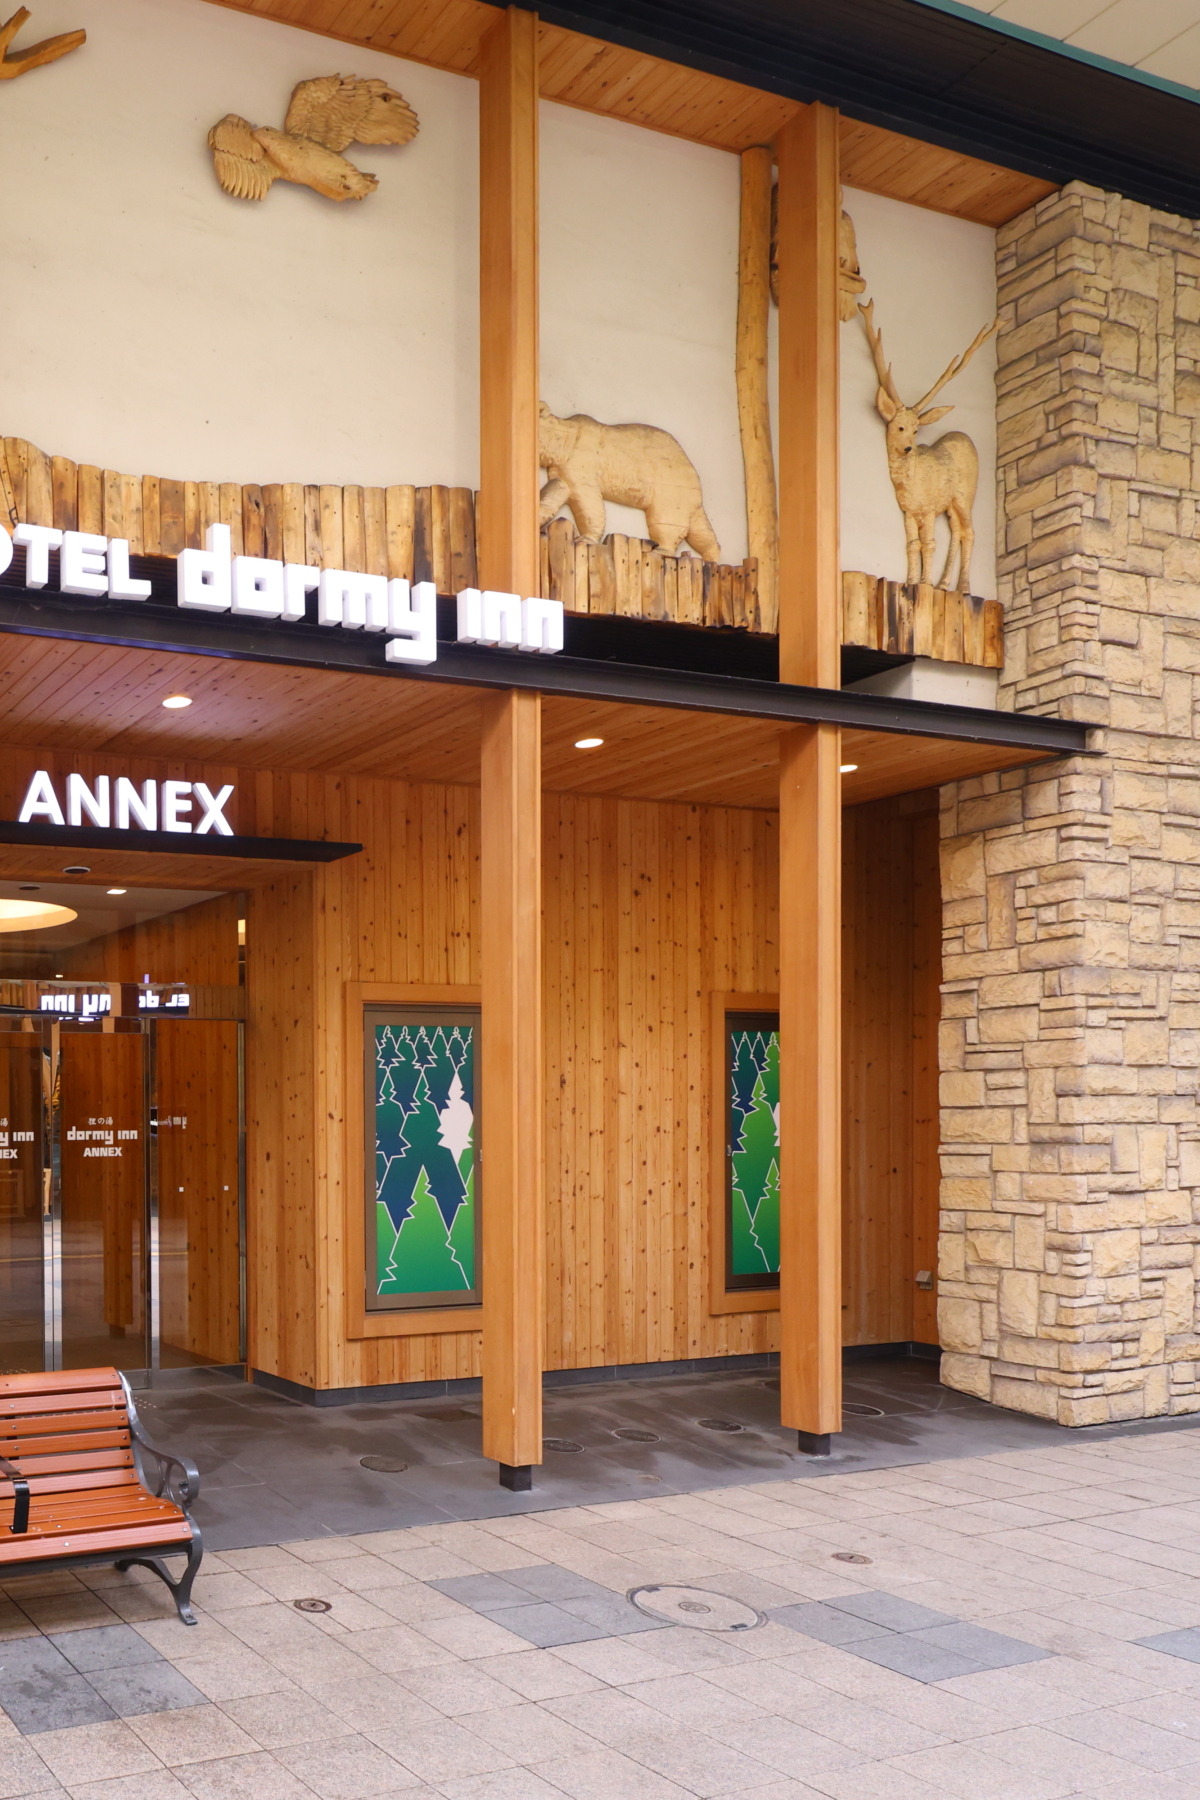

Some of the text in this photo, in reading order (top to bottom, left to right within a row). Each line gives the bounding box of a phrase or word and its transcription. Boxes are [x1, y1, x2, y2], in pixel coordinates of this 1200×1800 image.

[177, 523, 437, 665] dormy
[457, 588, 564, 654] inn
[18, 770, 235, 836] ANNEX
[13, 1131, 34, 1142] inn
[67, 1126, 138, 1145] dormy inn
[83, 1147, 123, 1157] ANNEX
